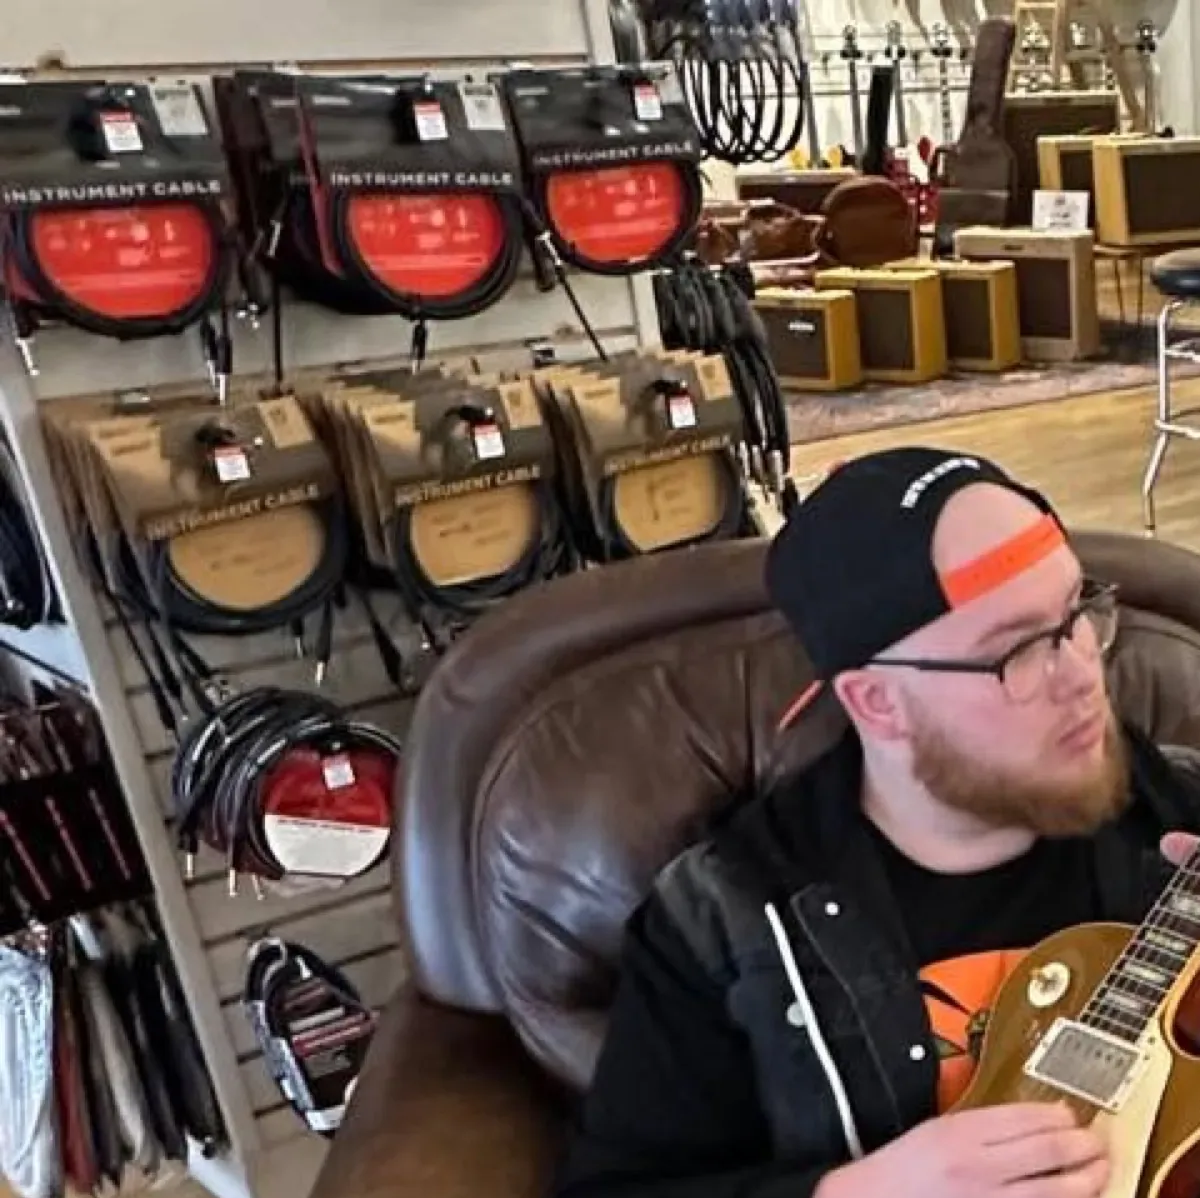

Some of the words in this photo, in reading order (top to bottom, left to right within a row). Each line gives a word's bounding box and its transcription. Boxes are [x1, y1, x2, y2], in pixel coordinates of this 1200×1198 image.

[533, 147, 638, 166] INSTRUMENT
[642, 140, 693, 157] CABLE
[331, 171, 450, 186] INSTRUMENT
[454, 171, 513, 186] CABLE
[3, 183, 147, 204] INSTRUMENT
[153, 179, 221, 196] CABLE
